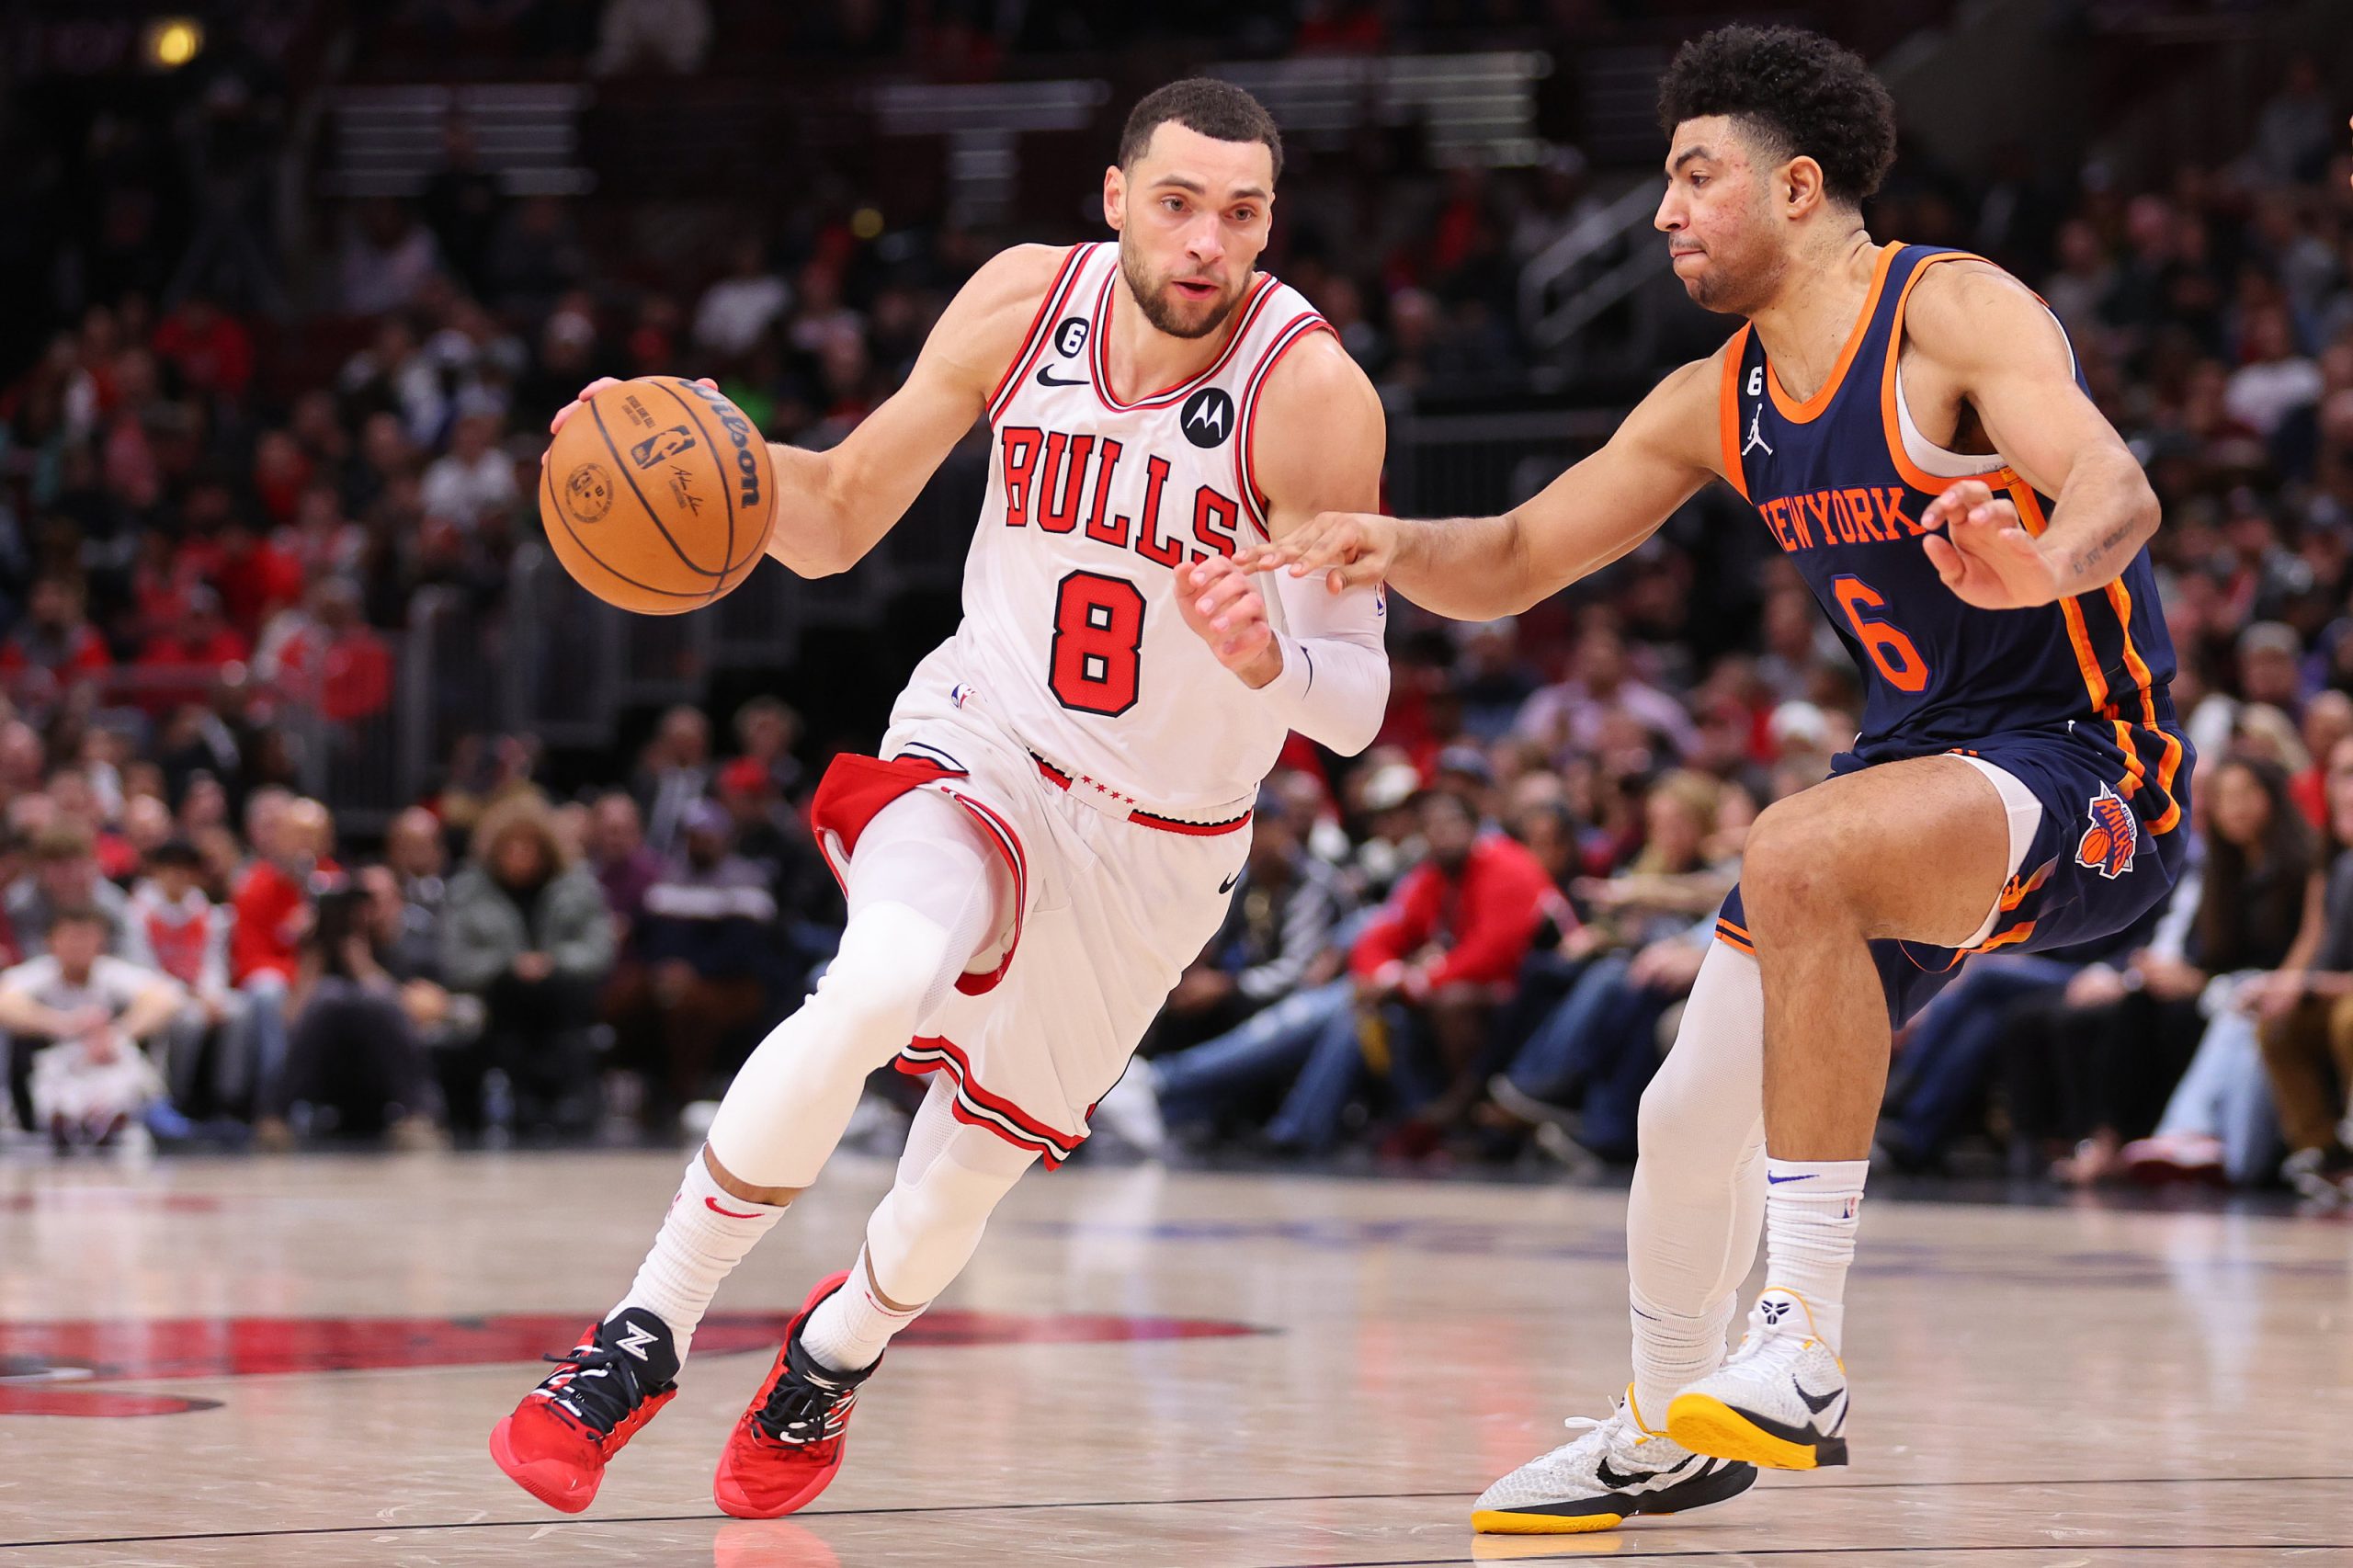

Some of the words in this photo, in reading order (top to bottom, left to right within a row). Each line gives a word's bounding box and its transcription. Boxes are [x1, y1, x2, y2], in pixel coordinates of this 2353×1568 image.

[1062, 322, 1086, 355] 6
[1746, 366, 1763, 396] 6
[1001, 426, 1239, 570] BULLS
[1804, 486, 1927, 545] YORK
[1048, 569, 1147, 718] 8
[1830, 573, 1932, 696] 6
[2093, 798, 2132, 875] KNICKS
